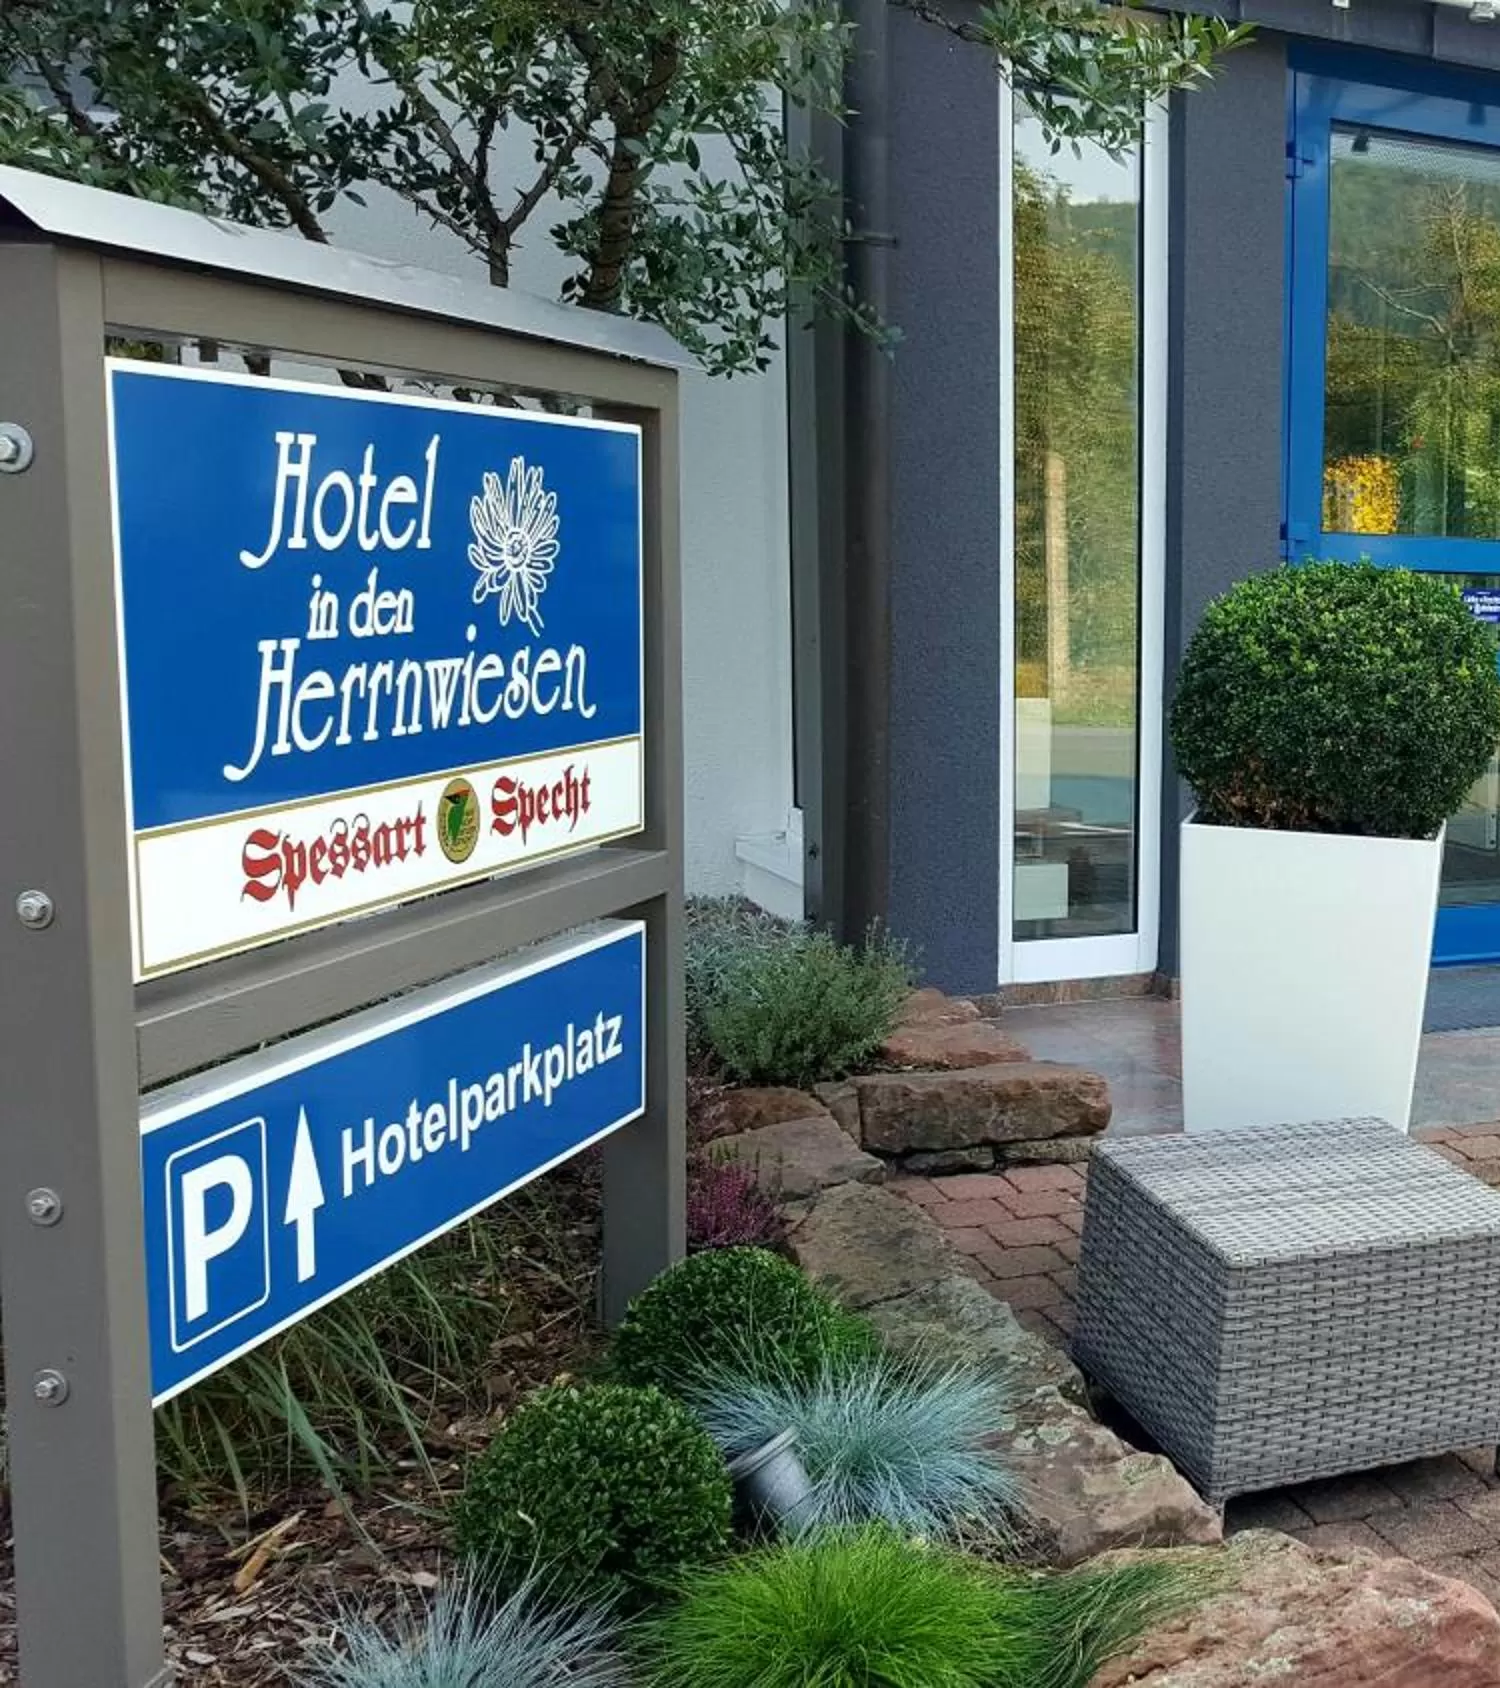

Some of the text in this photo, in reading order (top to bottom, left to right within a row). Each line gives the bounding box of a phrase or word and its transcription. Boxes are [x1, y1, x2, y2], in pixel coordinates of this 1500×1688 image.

[240, 430, 439, 568] Hotel
[307, 567, 415, 640] in den
[223, 625, 597, 782] Herrnwiesen
[240, 764, 592, 911] Spessart Specht
[181, 1010, 622, 1323] P Hotelparkplatz
